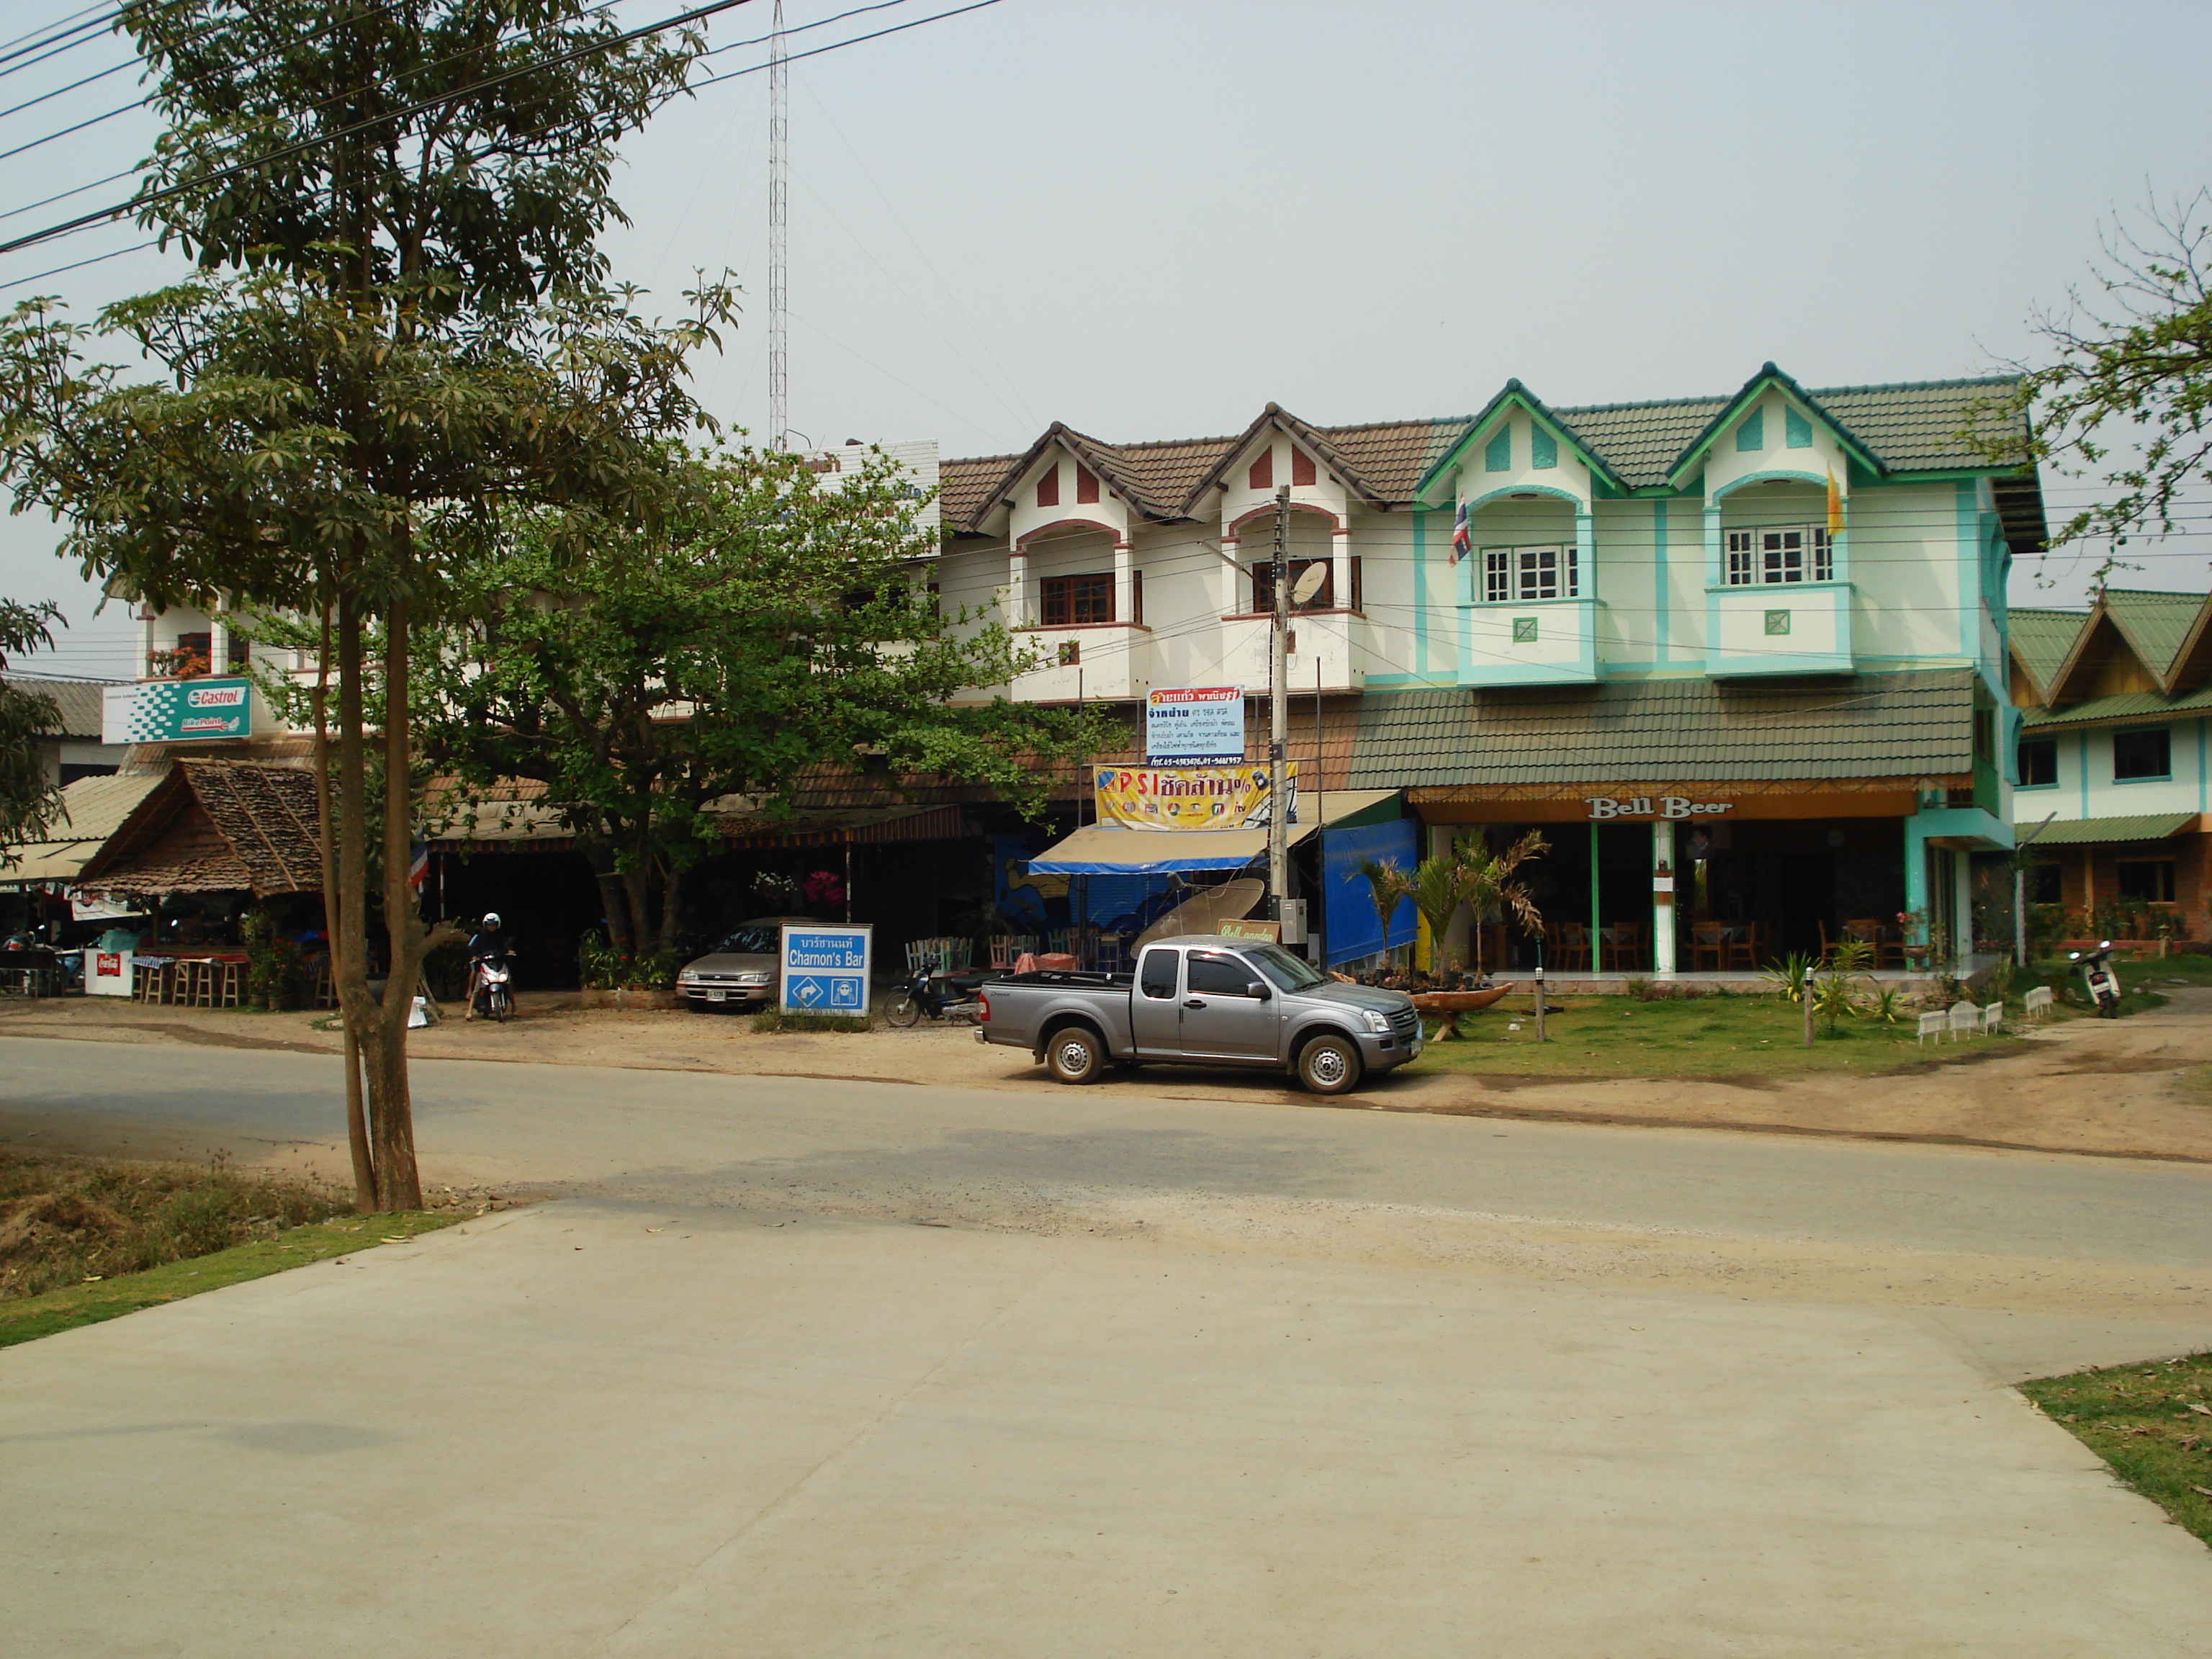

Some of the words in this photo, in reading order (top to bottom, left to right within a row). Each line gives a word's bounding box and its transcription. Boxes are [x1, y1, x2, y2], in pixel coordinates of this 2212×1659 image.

[201, 690, 238, 704] Castrol
[1148, 707, 1189, 718] จำหน่าย
[1119, 772, 1158, 795] PSI
[1585, 796, 1655, 819] Bell
[1659, 796, 1733, 819] Beer
[789, 949, 841, 966] Charnon's
[845, 951, 863, 966] Bar
